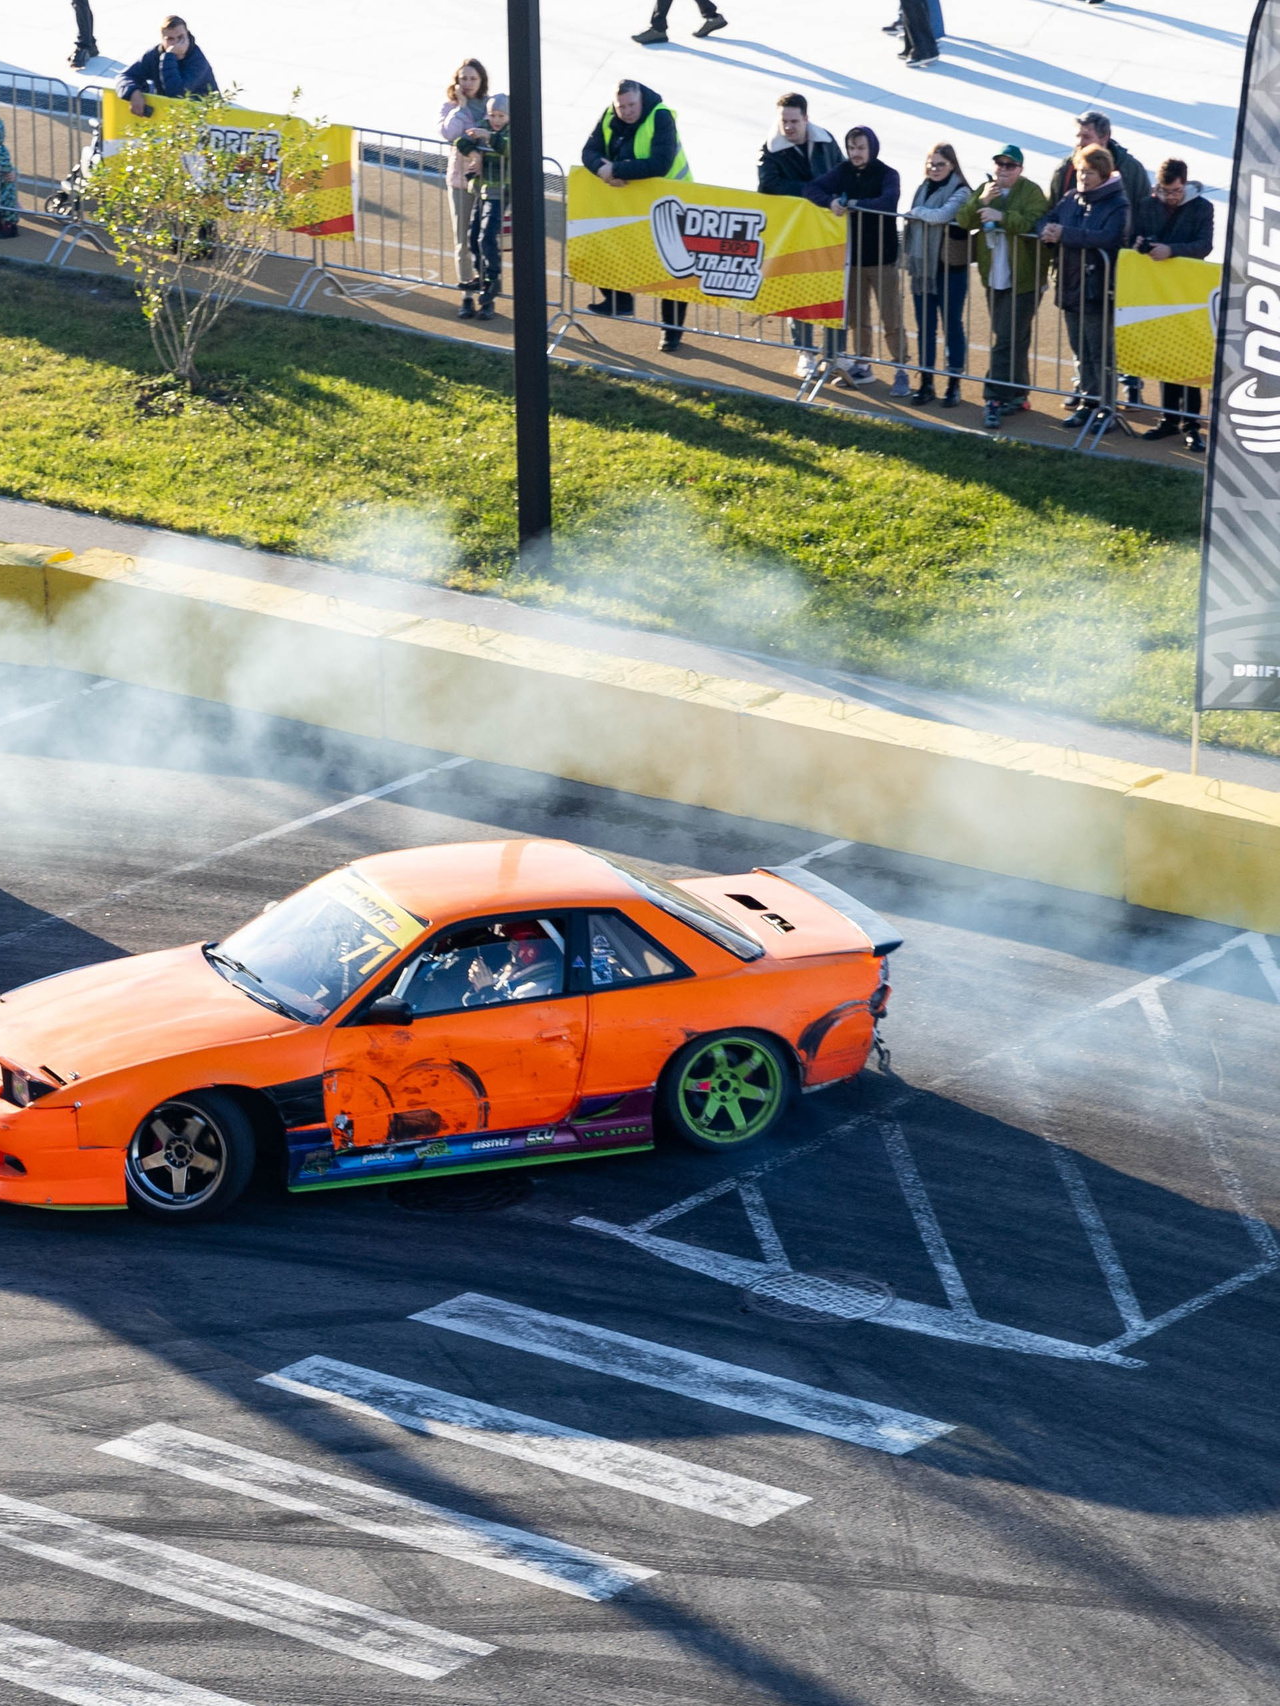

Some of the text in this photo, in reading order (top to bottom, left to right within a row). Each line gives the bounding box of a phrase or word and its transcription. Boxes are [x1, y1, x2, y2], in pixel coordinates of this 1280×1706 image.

[684, 209, 761, 240] DRIFT
[720, 241, 750, 253] EXPO
[697, 254, 756, 274] TRACK
[705, 271, 757, 291] MODE
[526, 1129, 555, 1142] ECU
